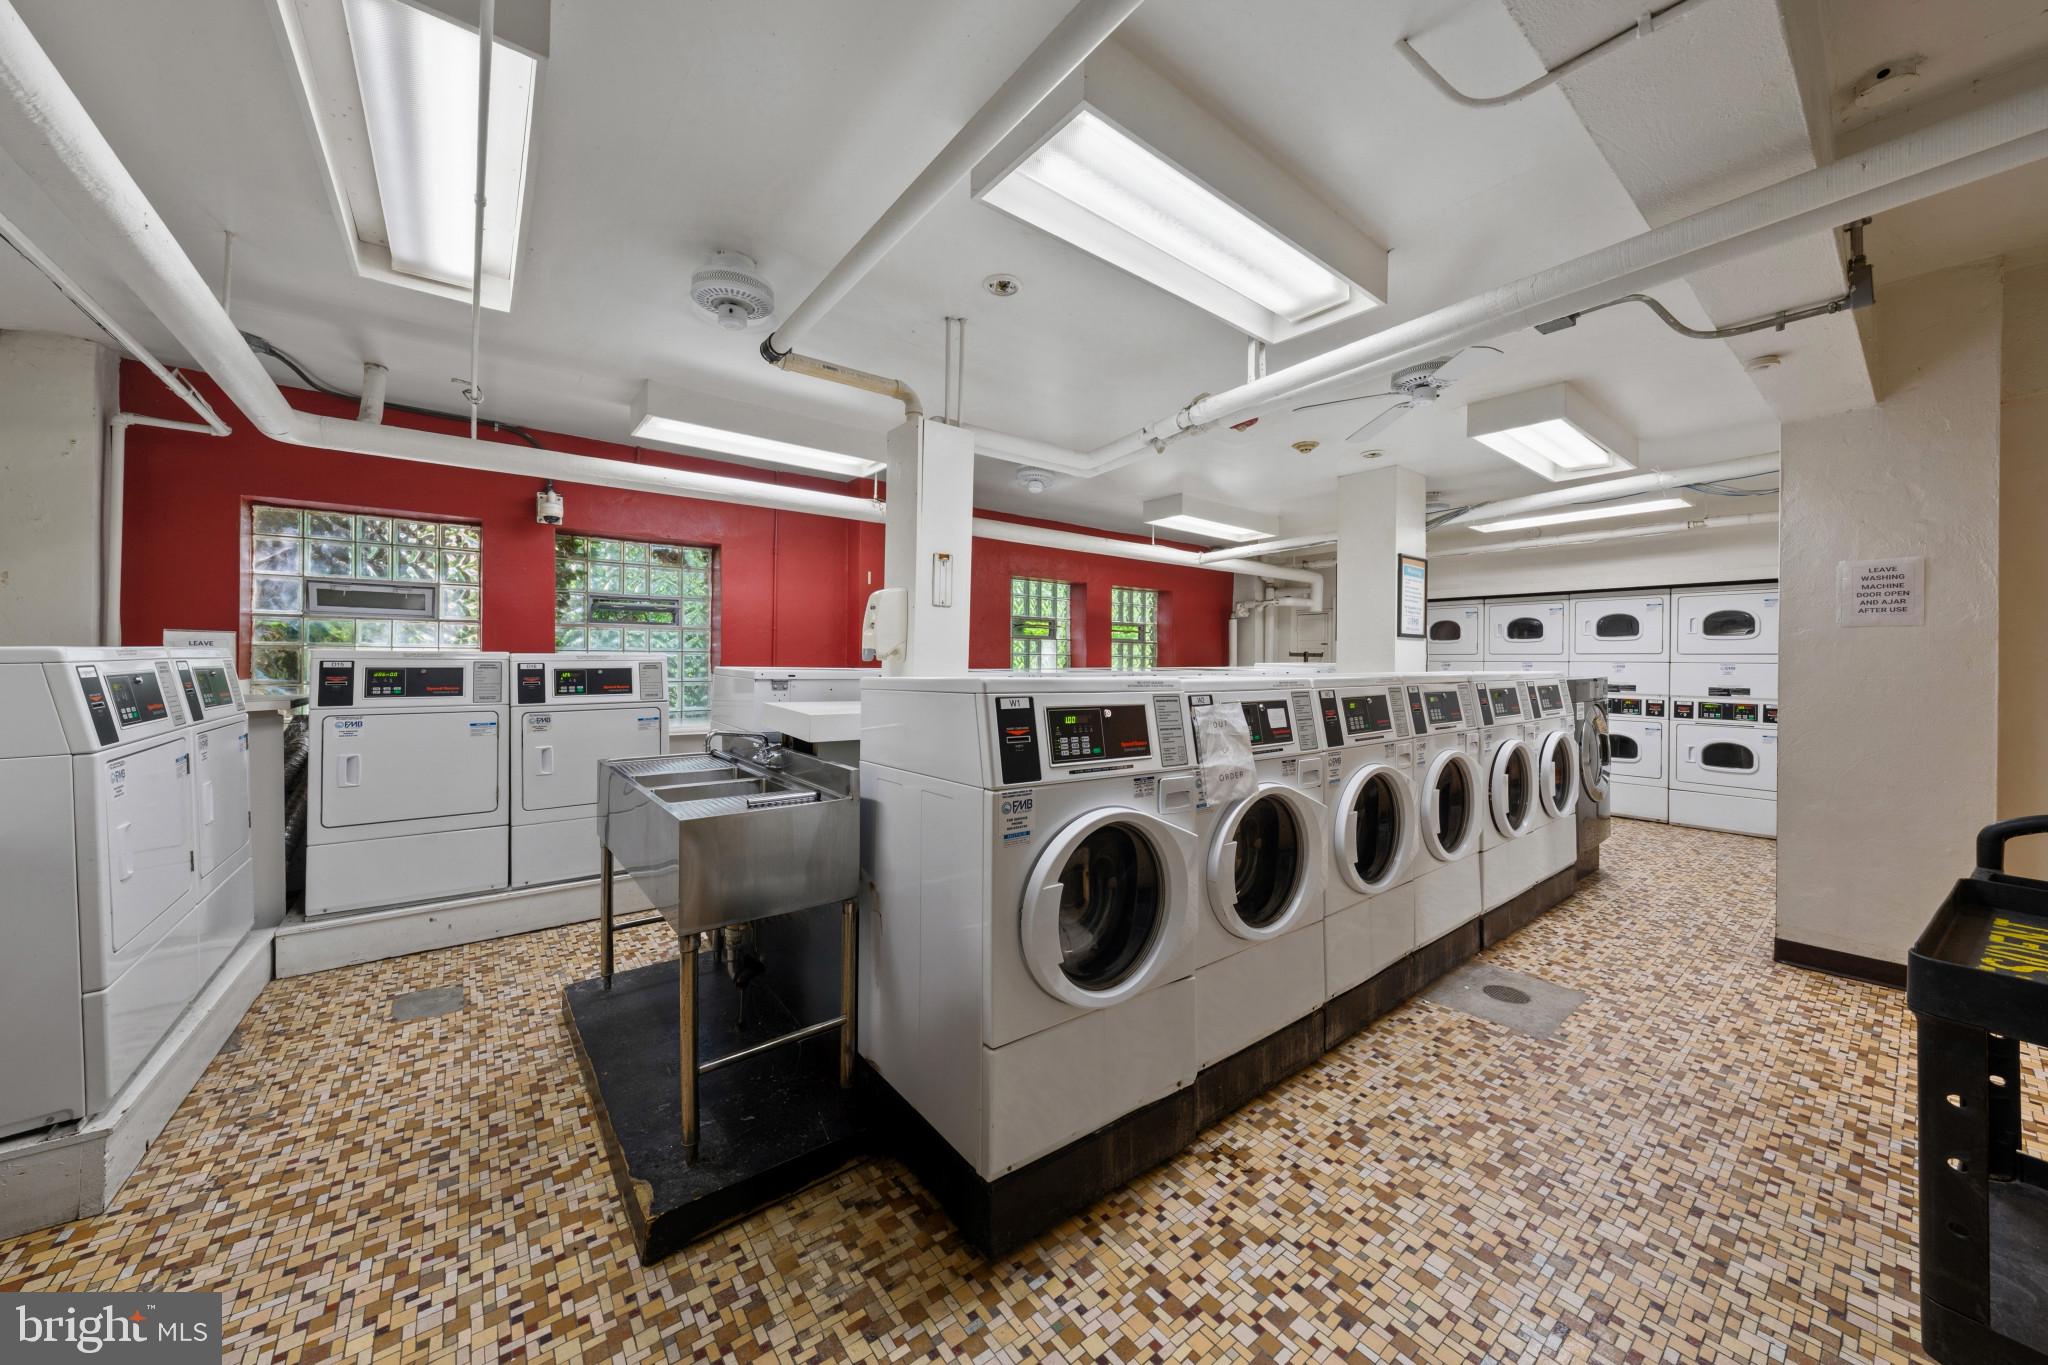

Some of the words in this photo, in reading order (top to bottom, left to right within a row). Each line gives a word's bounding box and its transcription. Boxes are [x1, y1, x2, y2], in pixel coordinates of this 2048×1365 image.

[1009, 699, 1021, 707] W1
[1218, 771, 1244, 782] ORDER
[1012, 799, 1033, 814] FMB
